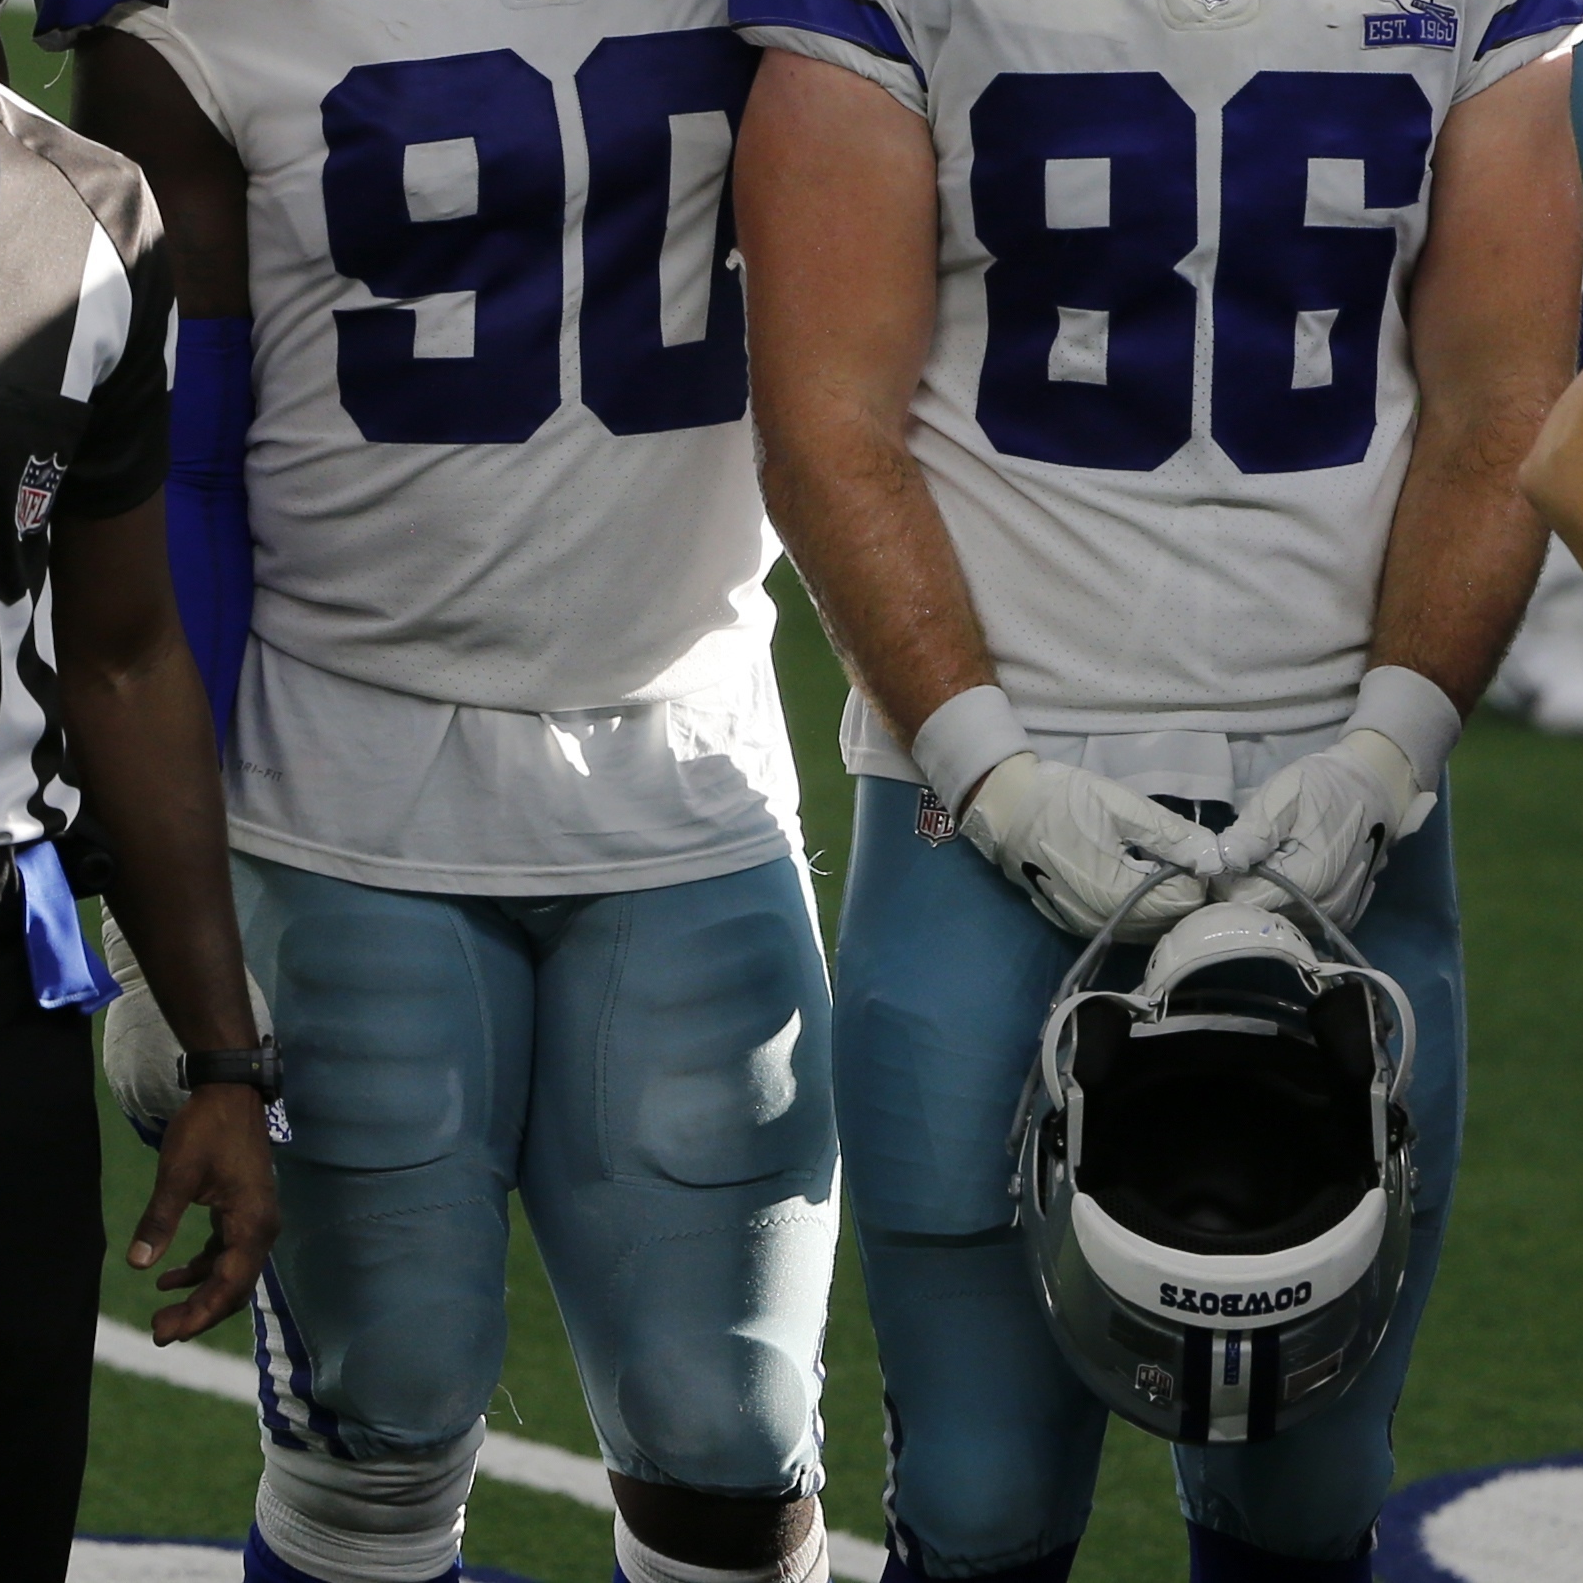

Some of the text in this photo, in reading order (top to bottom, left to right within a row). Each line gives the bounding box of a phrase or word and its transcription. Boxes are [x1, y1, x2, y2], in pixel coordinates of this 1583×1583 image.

[1369, 19, 1455, 42] EST. 1960
[320, 28, 759, 444] 90
[970, 71, 1433, 474] 86
[17, 489, 53, 530] NFL
[922, 810, 955, 834] NFL
[1159, 1281, 1313, 1317] COWBOYS
